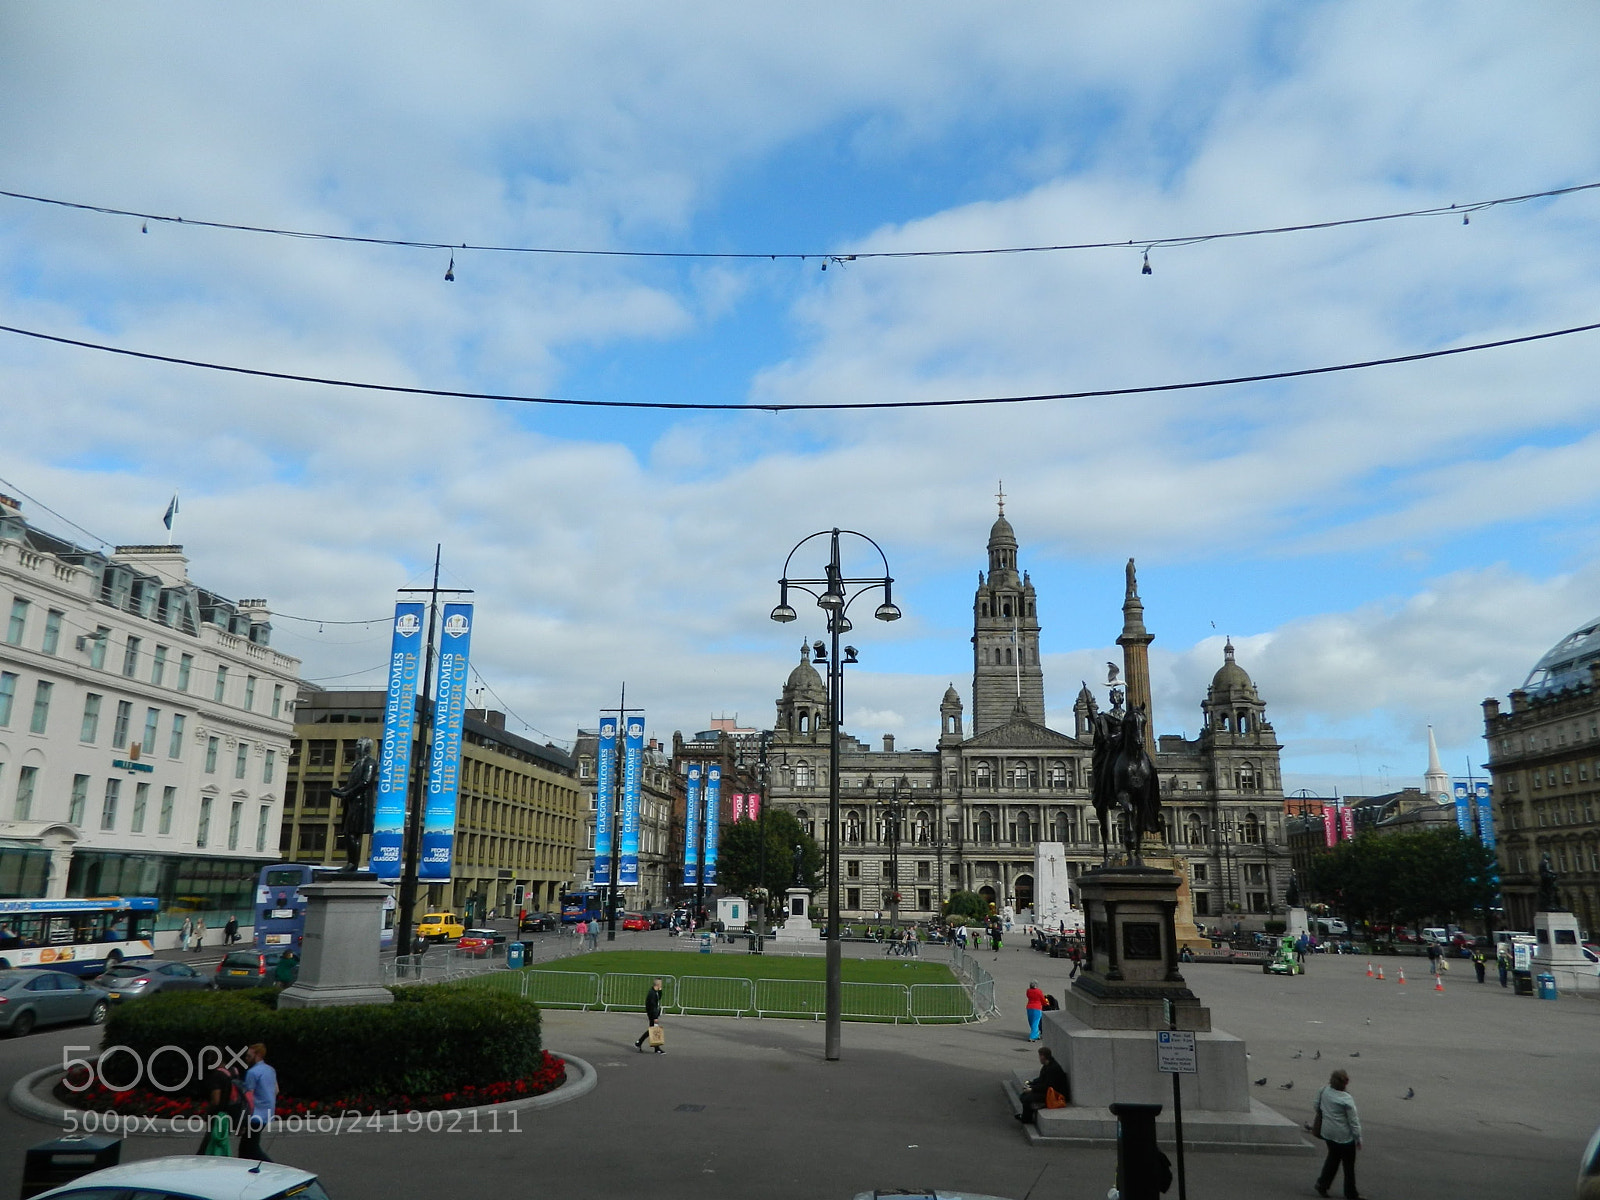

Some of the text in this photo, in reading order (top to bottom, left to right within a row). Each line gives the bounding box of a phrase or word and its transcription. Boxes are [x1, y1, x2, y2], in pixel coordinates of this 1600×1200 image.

[387, 653, 404, 724] WELCOMES
[436, 654, 453, 725] WELCOMES
[393, 652, 417, 794] THE 2014 RYDER CUP
[443, 654, 466, 794] THE 2014 RYDER CUP
[381, 728, 396, 793] GLASGOW
[430, 729, 445, 794] GLASGOW
[627, 748, 635, 791] WELCOMES
[1162, 1033, 1168, 1042] P
